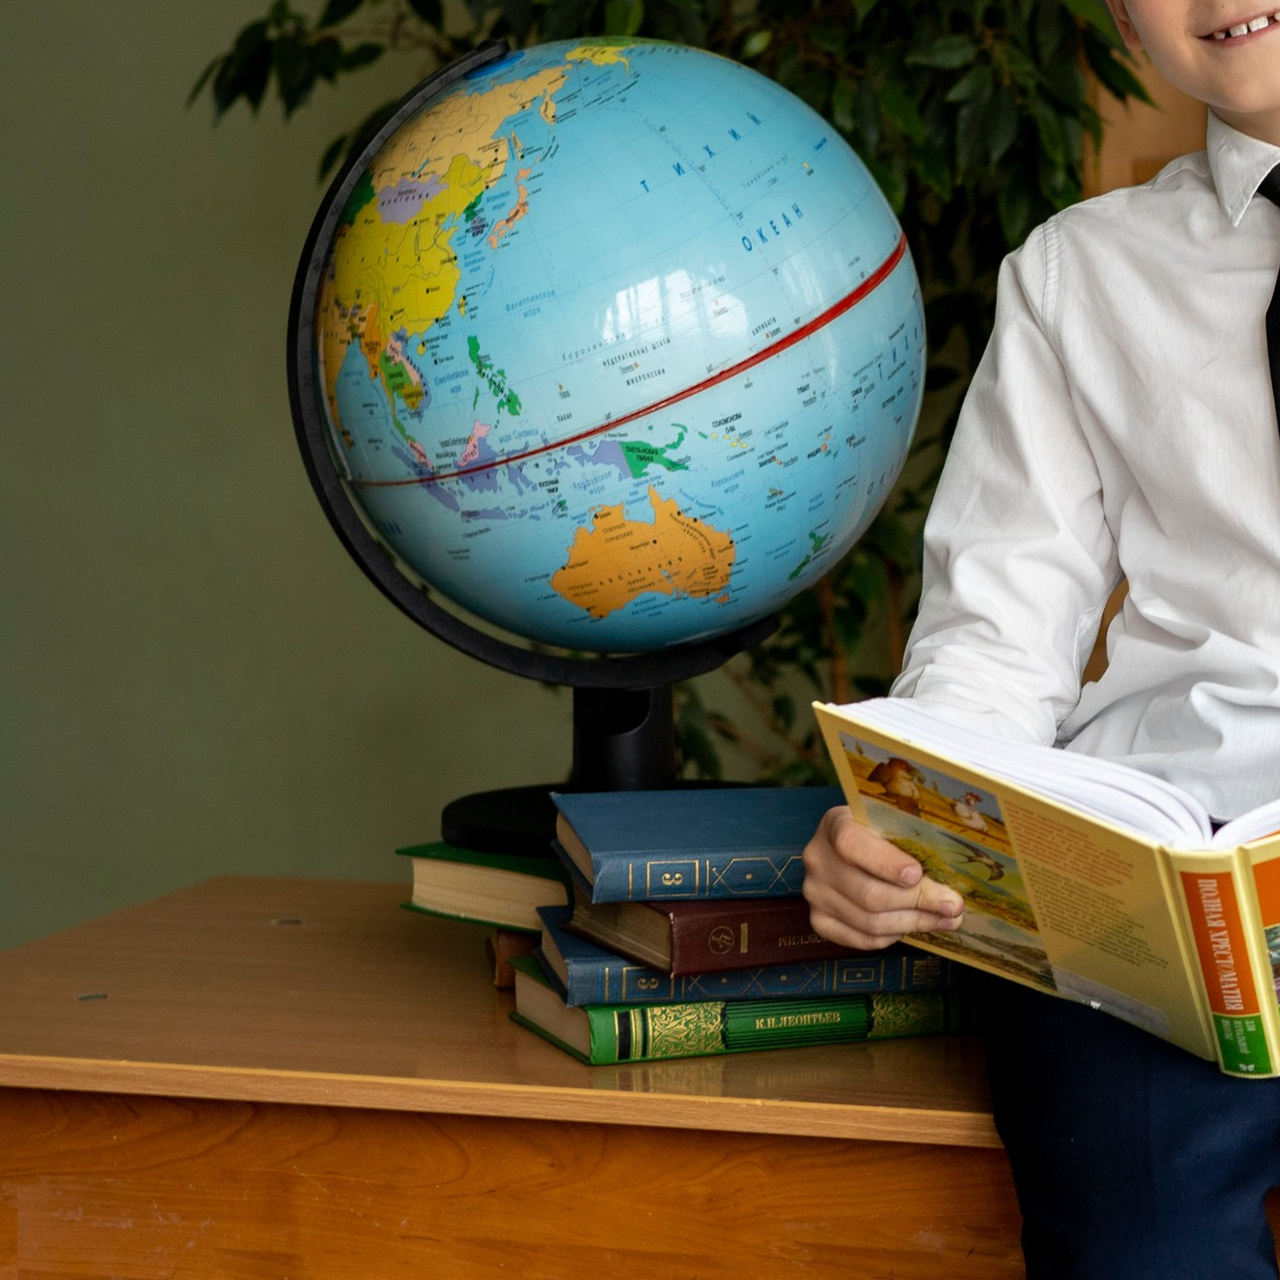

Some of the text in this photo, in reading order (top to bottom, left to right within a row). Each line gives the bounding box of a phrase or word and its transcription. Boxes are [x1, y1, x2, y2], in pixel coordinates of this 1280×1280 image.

[640, 111, 763, 194] ТИХИЙ
[741, 203, 804, 252] ОКЕАН
[1197, 878, 1226, 928] ПОЛНАЯ
[1209, 929, 1244, 1011] ХРЕСТОМАТИЯ
[777, 1011, 841, 1029] ЛЕОНТЬЕВ
